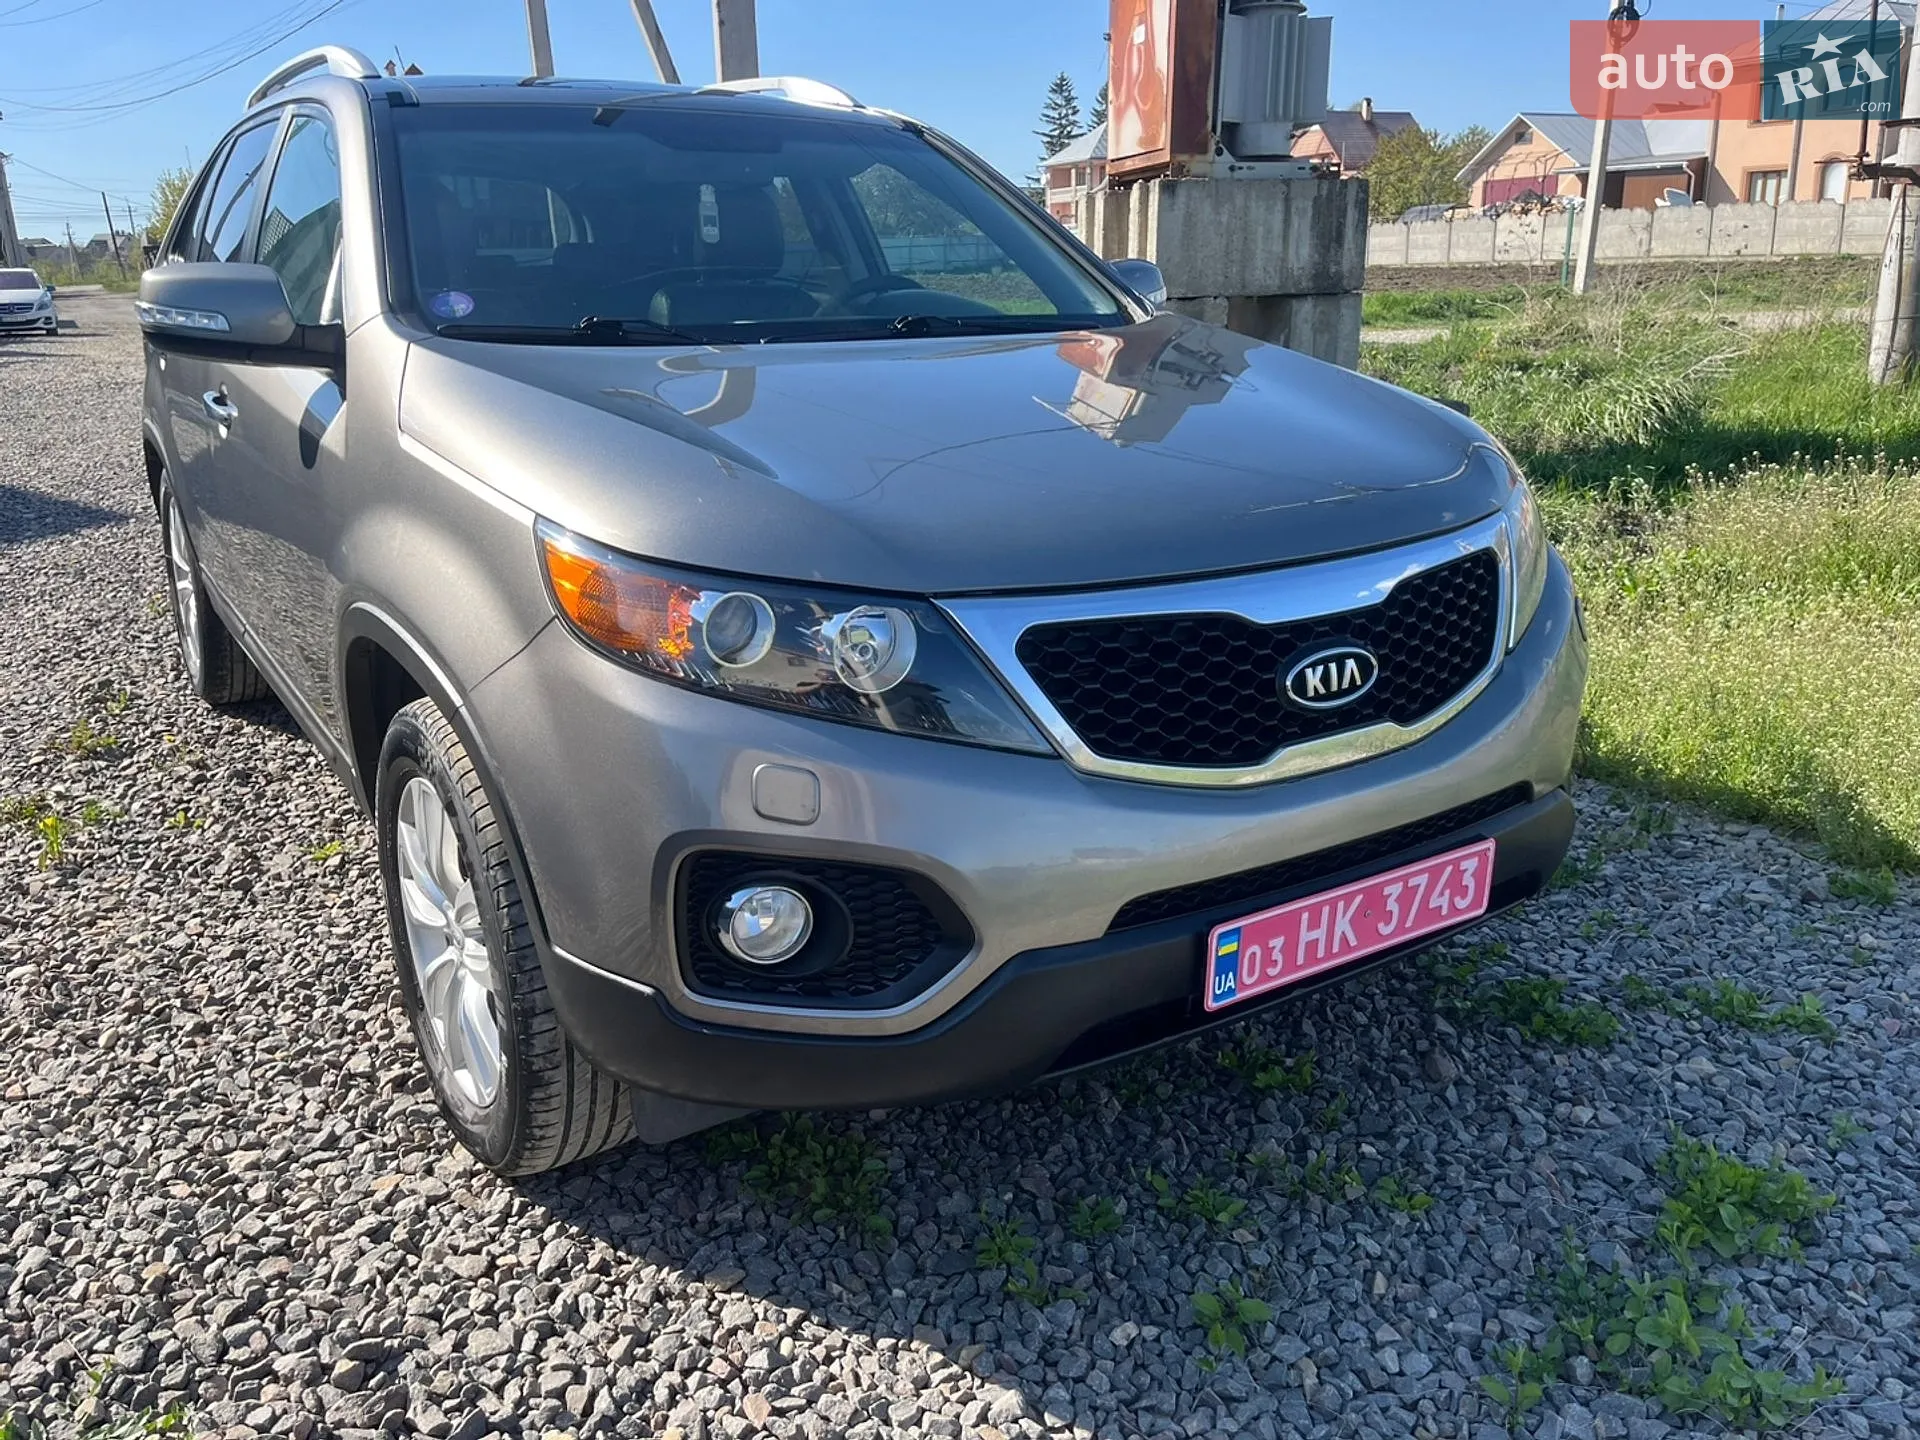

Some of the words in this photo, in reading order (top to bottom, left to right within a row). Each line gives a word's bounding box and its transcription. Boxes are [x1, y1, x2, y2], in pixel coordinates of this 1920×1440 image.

[1304, 658, 1362, 697] KIA
[1242, 936, 1285, 986] 03
[1376, 859, 1479, 936] 3743
[1214, 971, 1236, 996] UA
